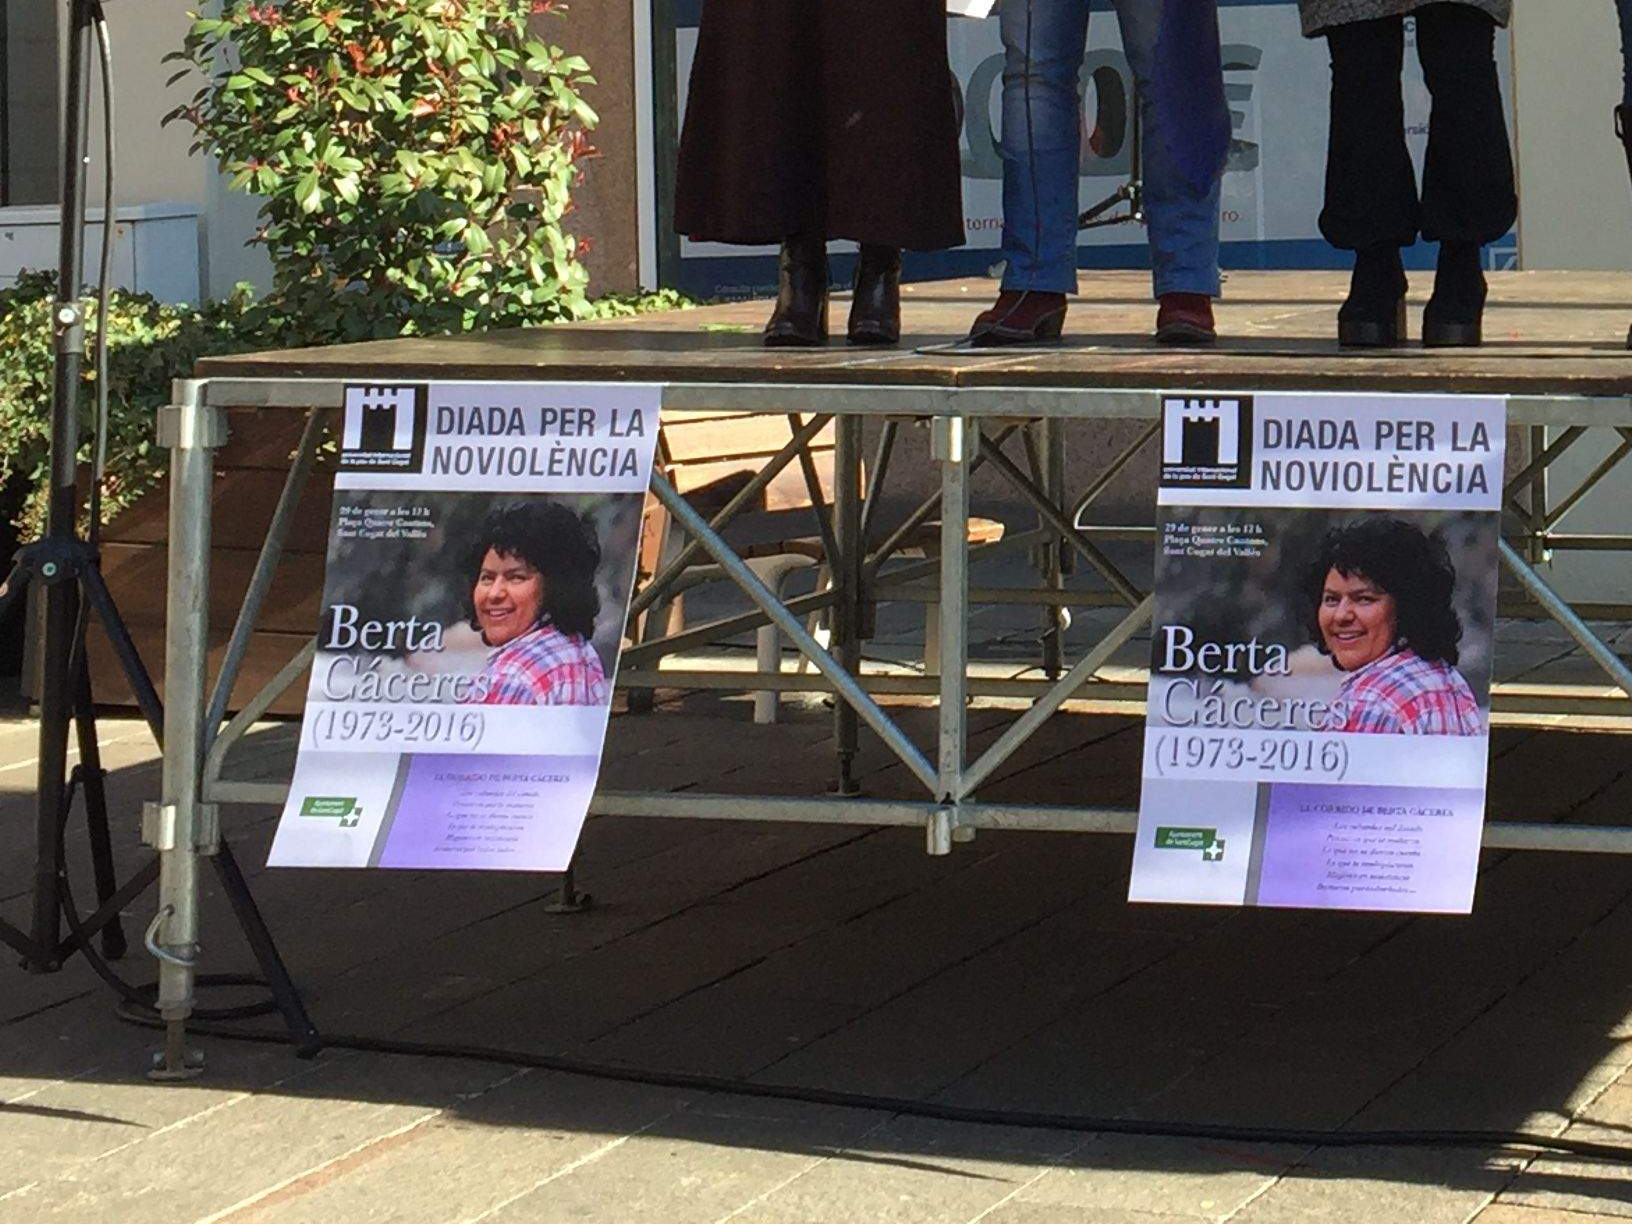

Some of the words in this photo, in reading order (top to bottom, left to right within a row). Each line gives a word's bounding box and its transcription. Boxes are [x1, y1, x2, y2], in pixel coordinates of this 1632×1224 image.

[436, 406, 525, 437] DIADA
[540, 407, 596, 437] PER
[609, 407, 646, 439] LA
[1262, 418, 1360, 450] DIADA
[1374, 419, 1434, 451] PER
[1451, 421, 1491, 453] LA
[431, 440, 641, 478] NOVIOLÈNCIA
[1260, 453, 1489, 495] NOVIOLÈNCIA
[324, 603, 445, 653] Berta
[1159, 625, 1291, 675] Berta
[320, 653, 489, 704] Cáceres
[1161, 676, 1349, 730] Cáceres
[311, 708, 487, 748] (1973-2016)
[1154, 733, 1350, 780] (1973-2016)
